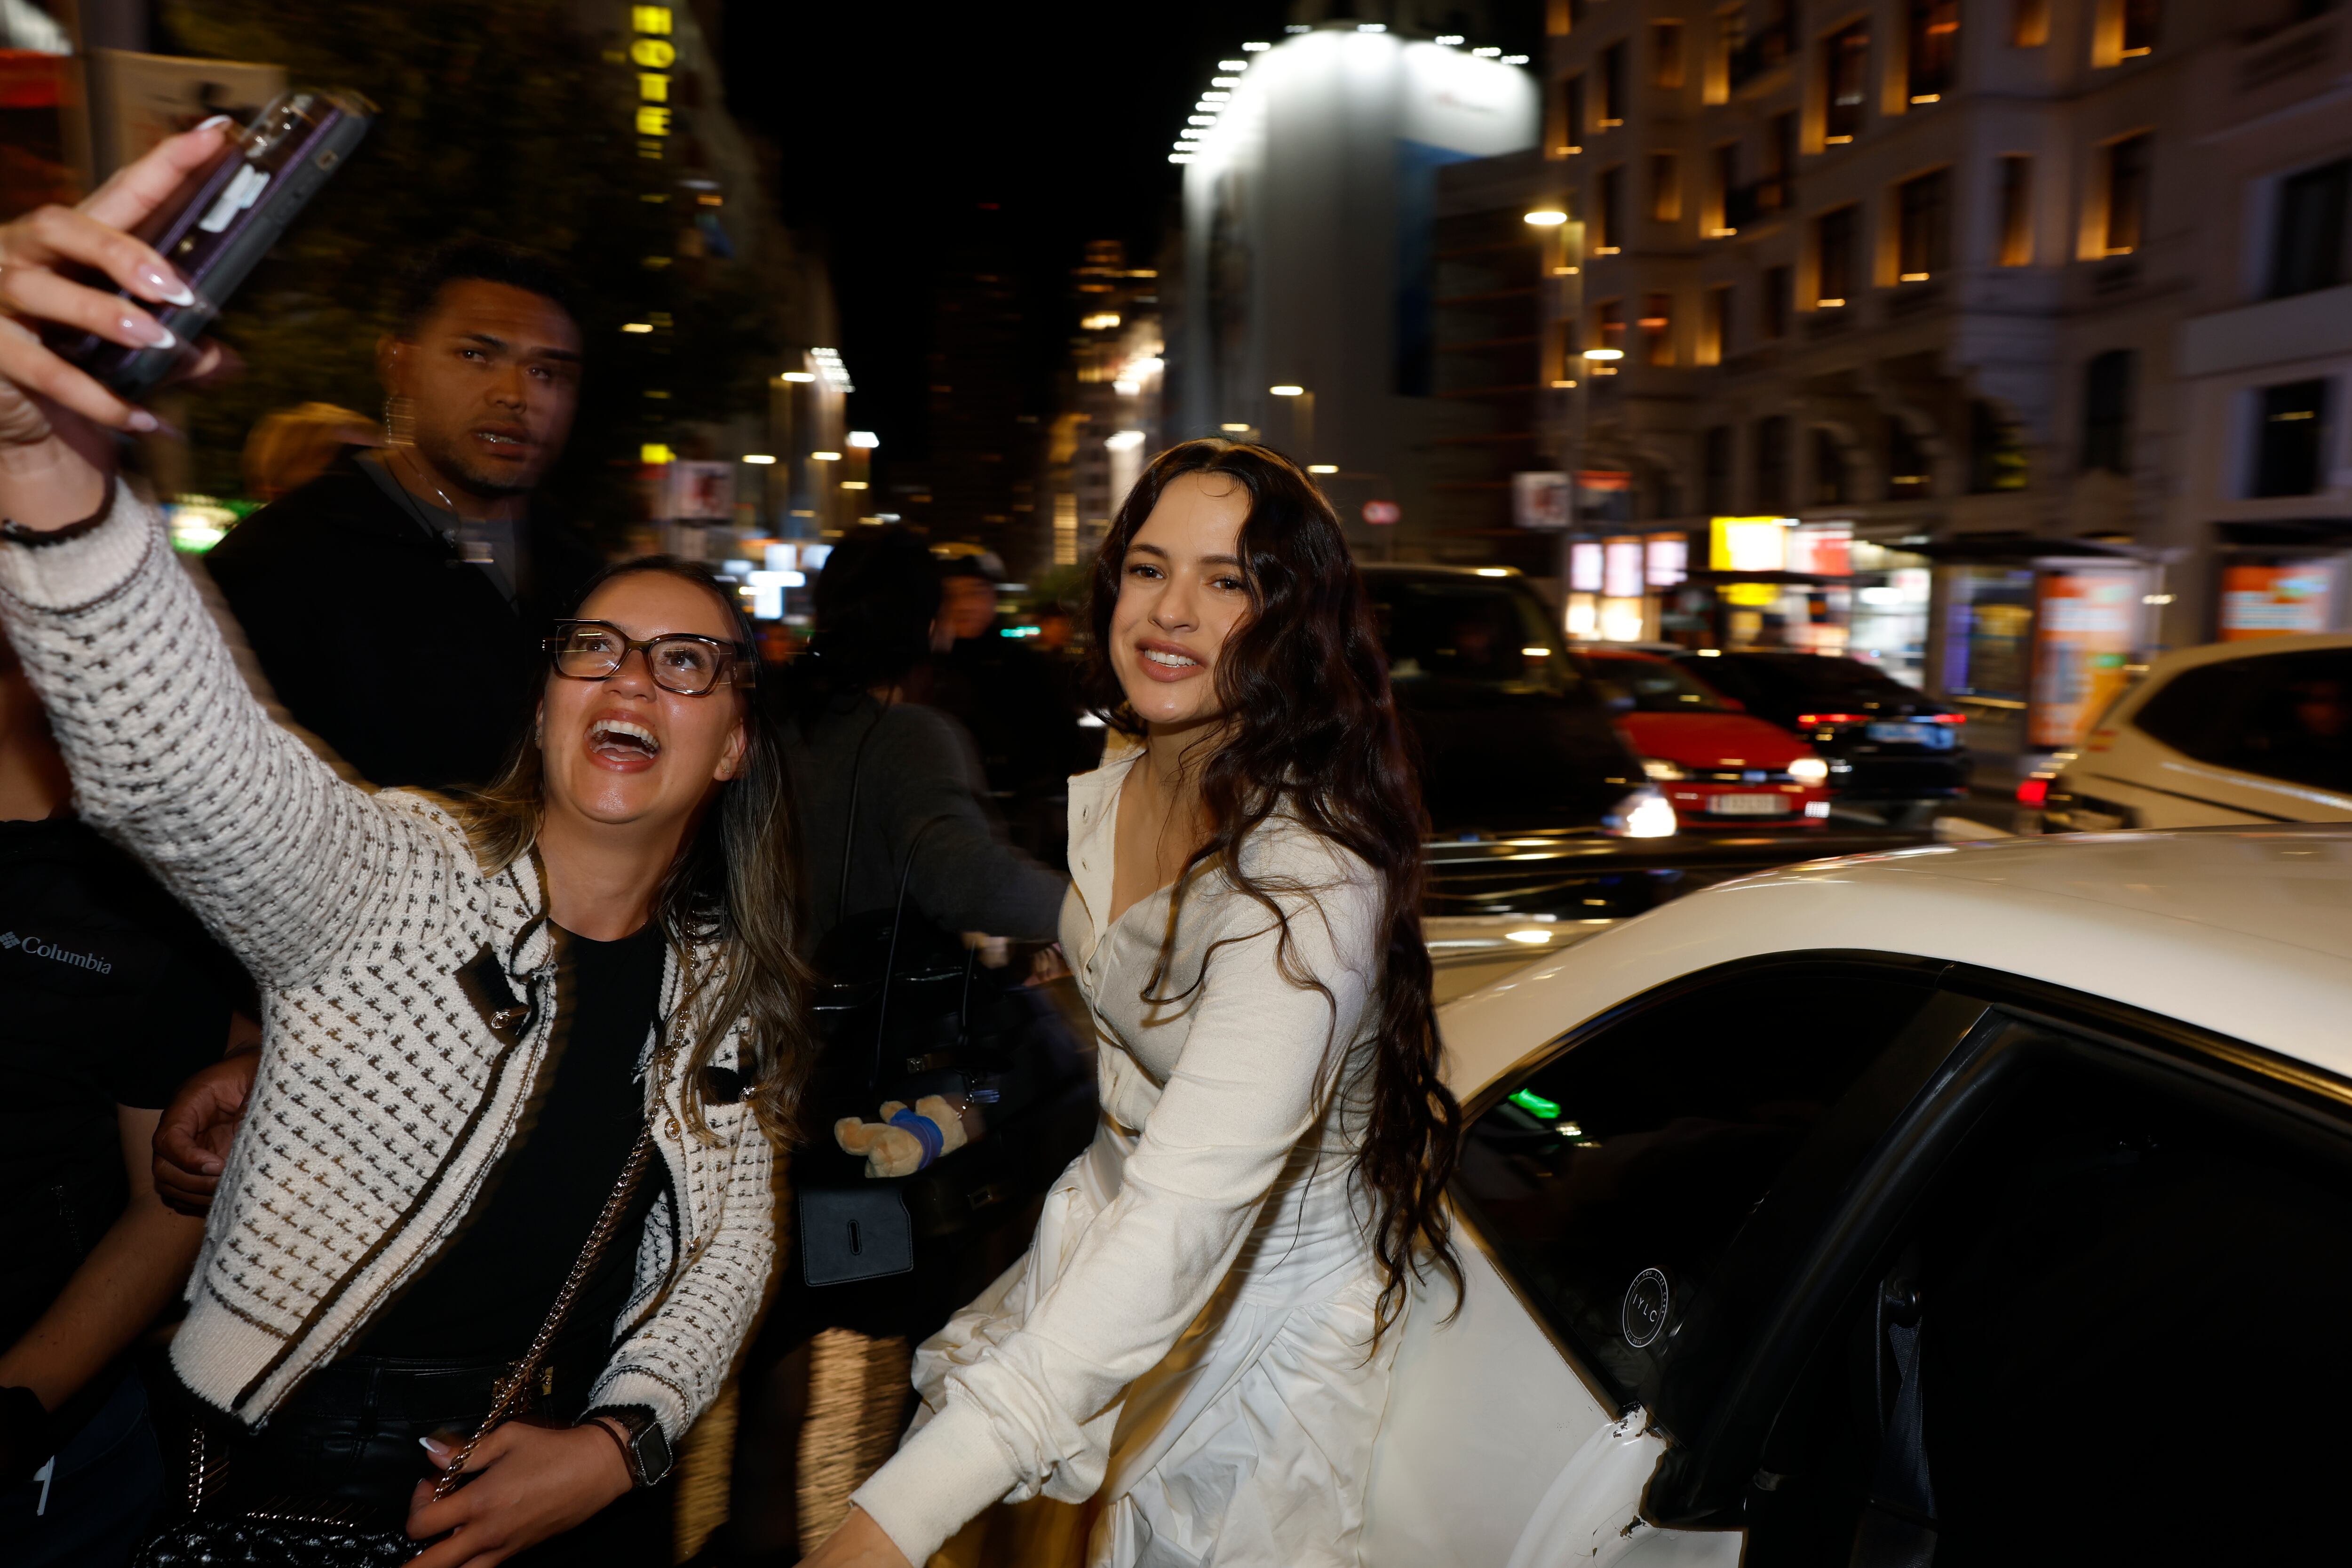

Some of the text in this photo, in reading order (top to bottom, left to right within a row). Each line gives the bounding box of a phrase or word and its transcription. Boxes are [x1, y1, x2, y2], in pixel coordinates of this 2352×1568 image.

[22, 936, 112, 974] Columbia
[1655, 1273, 1664, 1287] LIKE
[1633, 1293, 1657, 1322] IYLC
